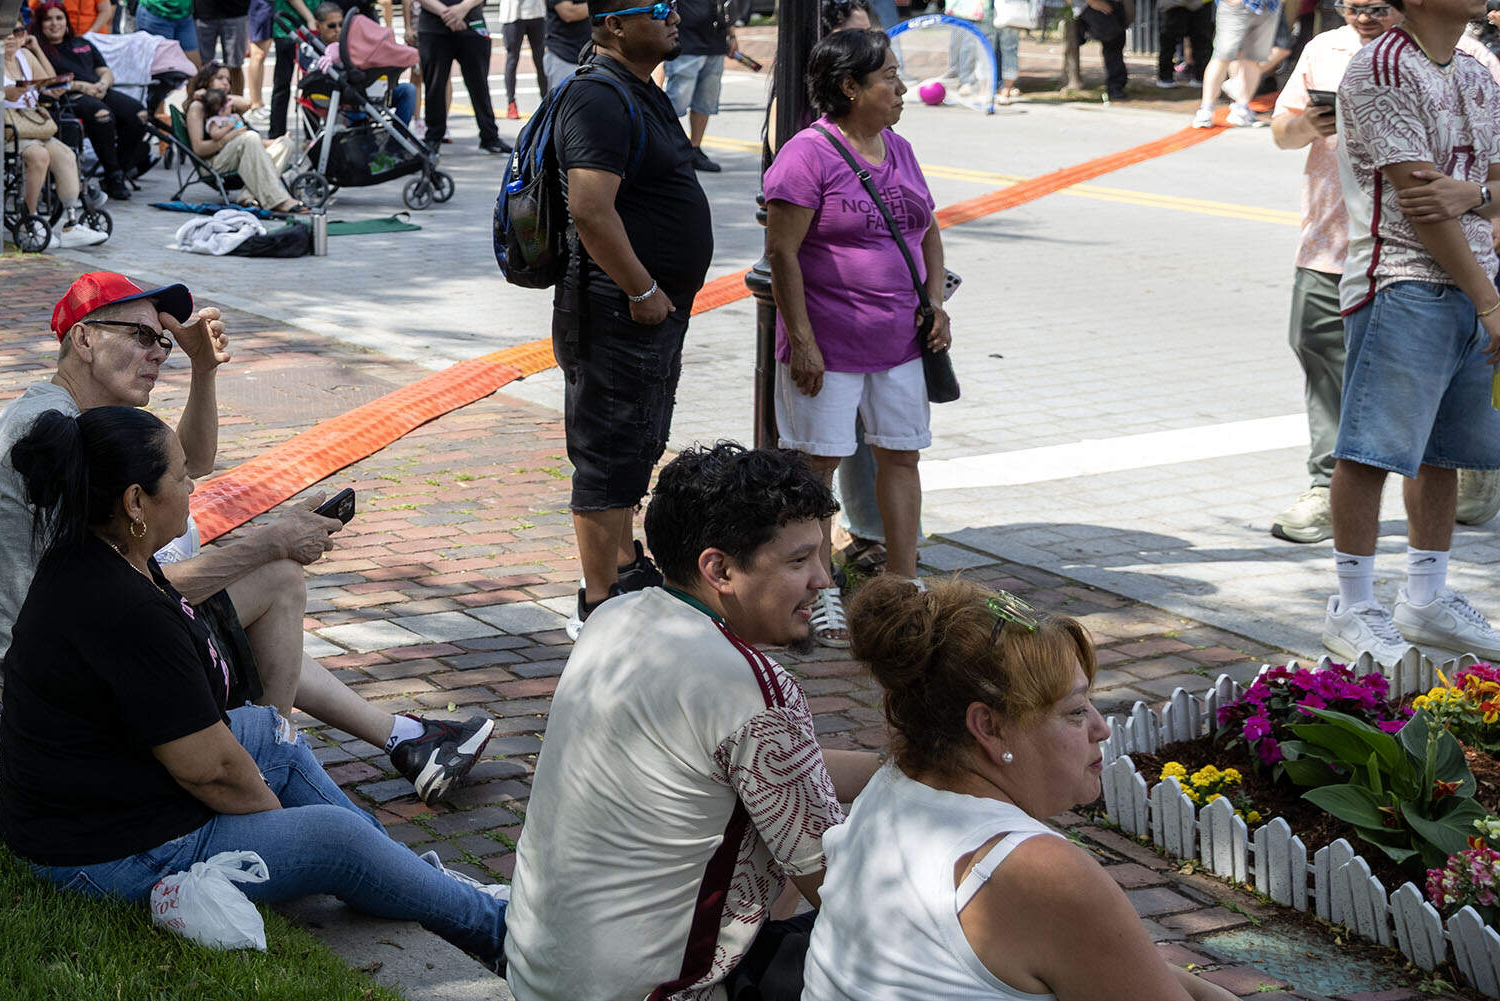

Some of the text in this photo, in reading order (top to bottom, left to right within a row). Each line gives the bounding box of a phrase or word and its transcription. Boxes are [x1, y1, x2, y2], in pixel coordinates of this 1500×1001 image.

[879, 186, 901, 200] HE
[841, 198, 905, 216] NORH
[866, 214, 906, 230] FAE
